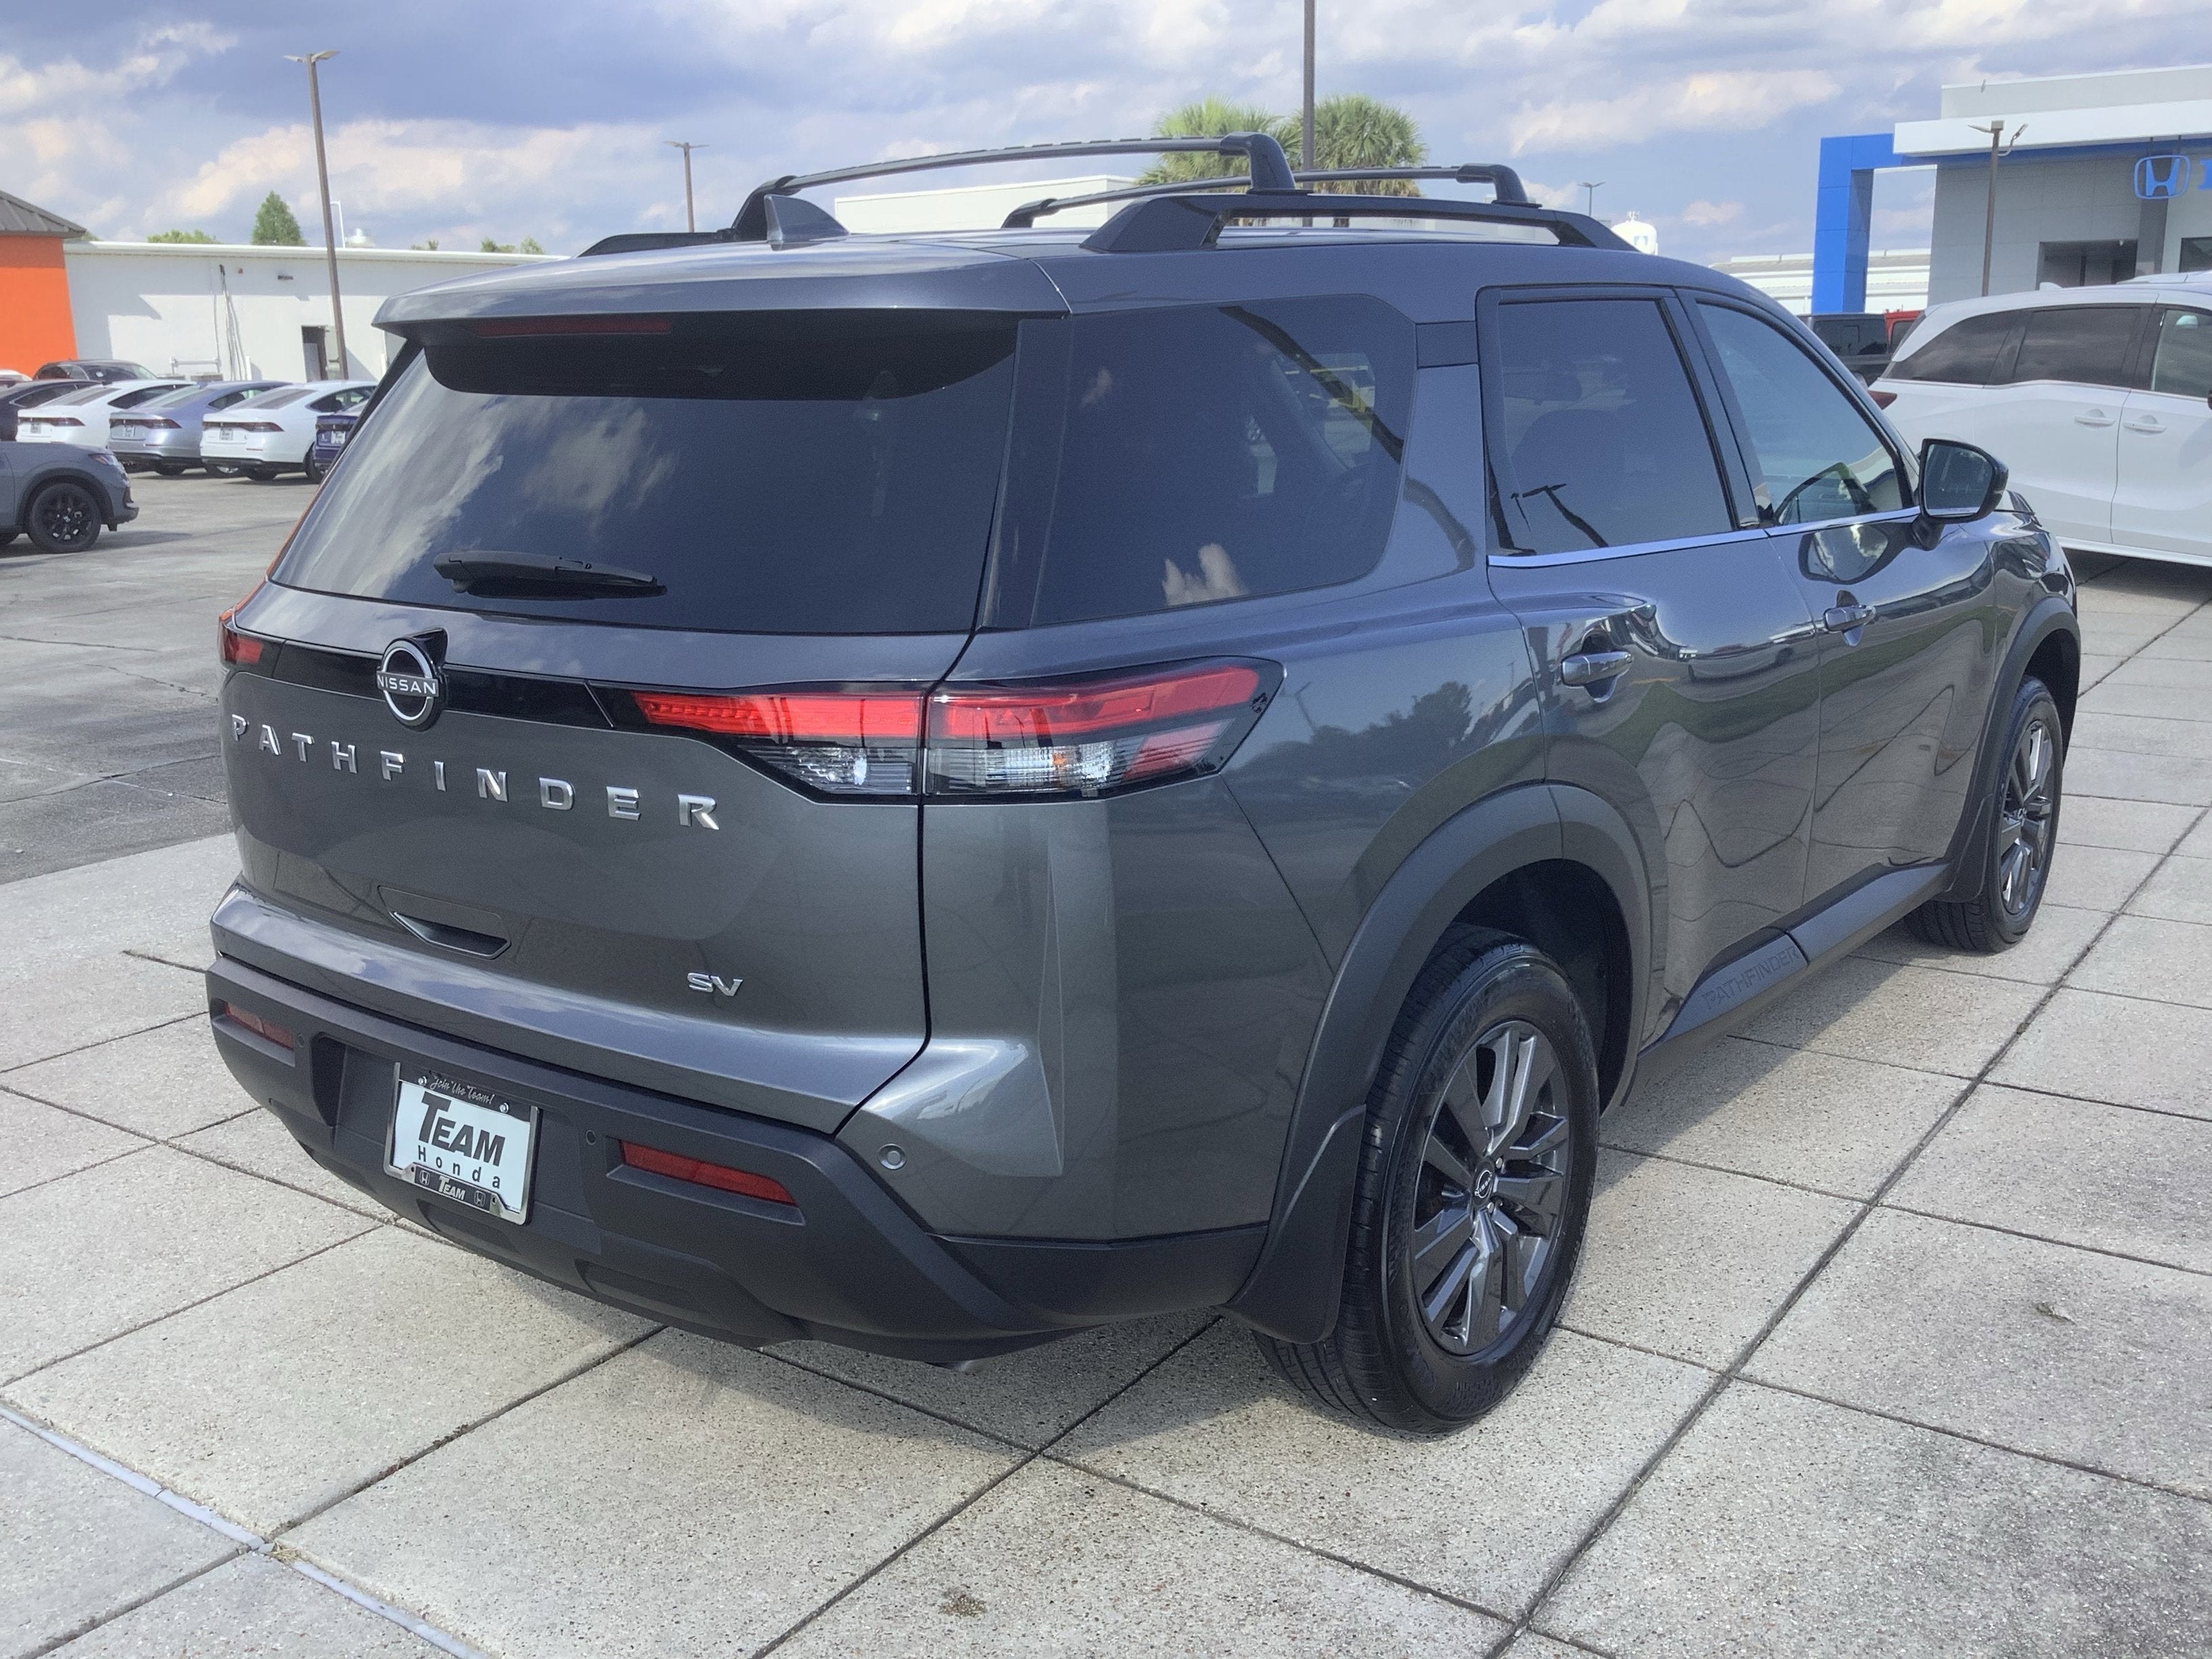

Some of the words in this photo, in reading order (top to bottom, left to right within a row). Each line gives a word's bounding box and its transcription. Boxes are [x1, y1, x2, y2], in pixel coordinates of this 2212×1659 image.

[377, 674, 436, 695] NISSAN
[231, 714, 720, 830] PATHFINDER
[687, 972, 743, 997] SV
[1701, 945, 1801, 1010] PATHFINDER
[418, 1091, 506, 1167] TEAM
[417, 1145, 501, 1189] Honda
[438, 1175, 466, 1201] TEAM
